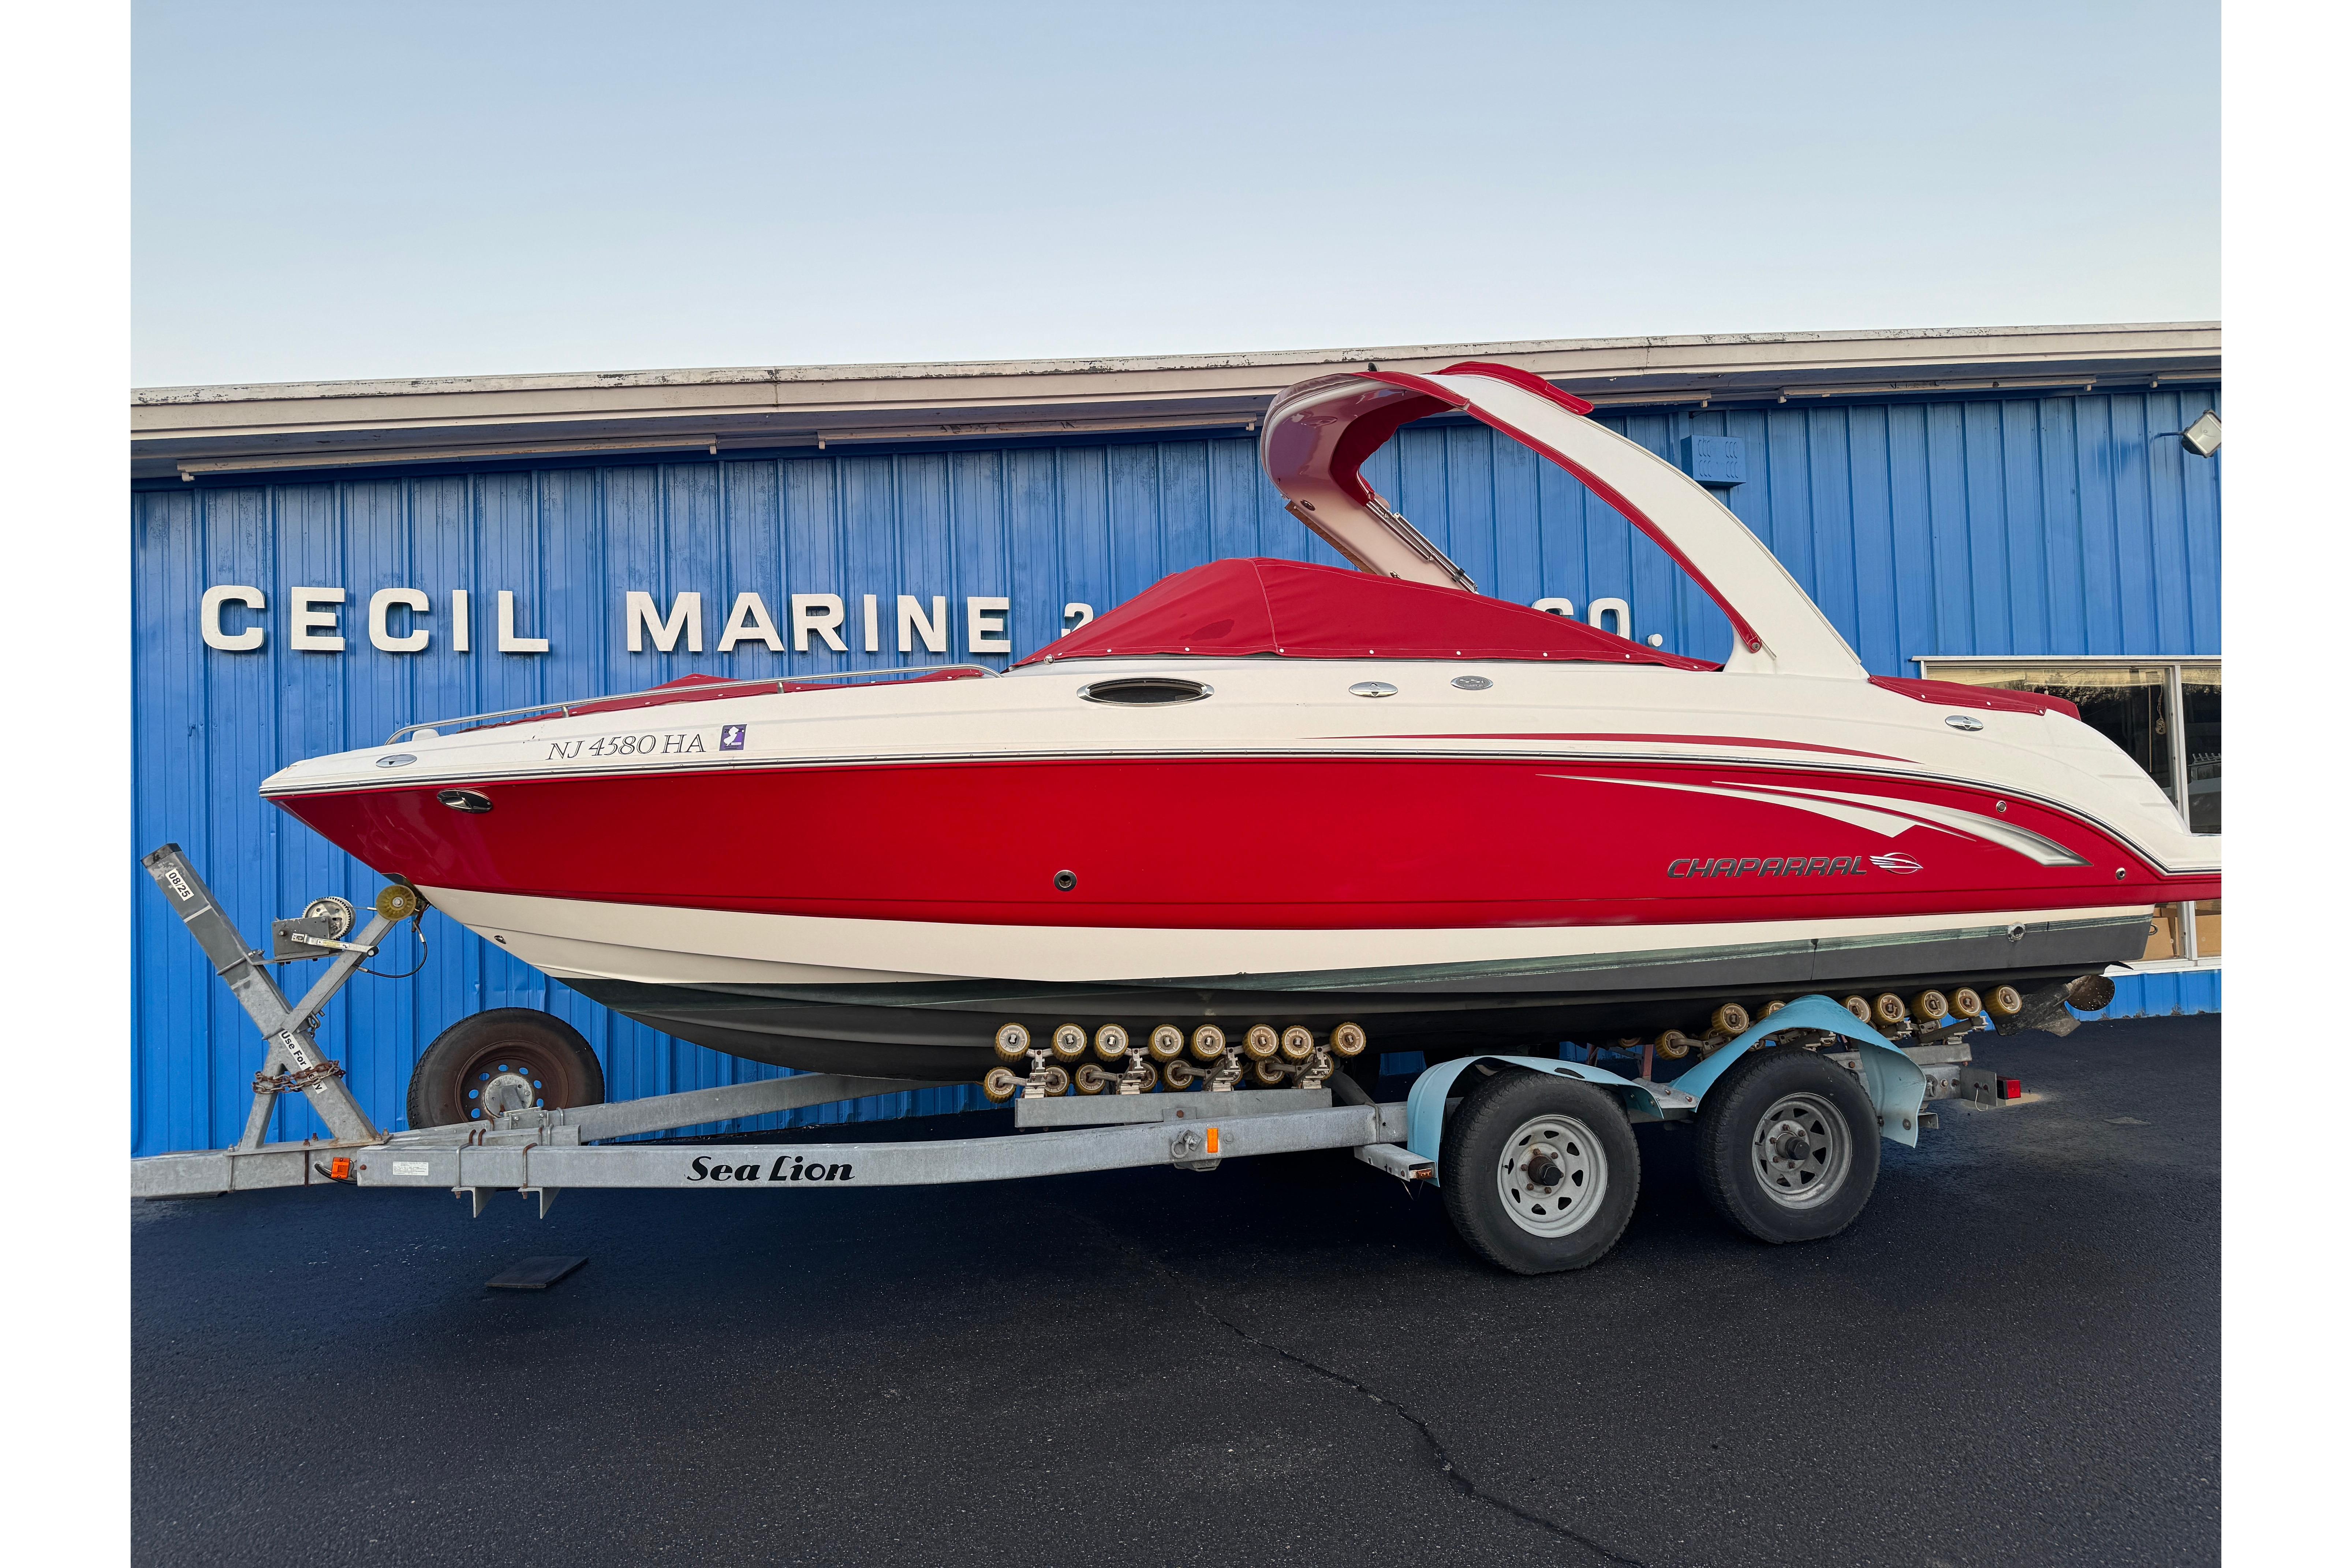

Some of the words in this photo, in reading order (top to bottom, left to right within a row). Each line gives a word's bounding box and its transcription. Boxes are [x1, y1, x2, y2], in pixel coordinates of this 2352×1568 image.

[201, 585, 549, 652] CECIL
[626, 591, 1011, 653] MARINE
[545, 740, 585, 760] NJ
[588, 735, 656, 756] 4580
[660, 733, 706, 754] HA
[1668, 856, 1867, 878] CHAPARRAL
[169, 872, 190, 897] 08/25
[281, 1031, 295, 1049] Use
[293, 1050, 307, 1065] For
[687, 1156, 761, 1181] Sea
[768, 1156, 855, 1181] Lion
